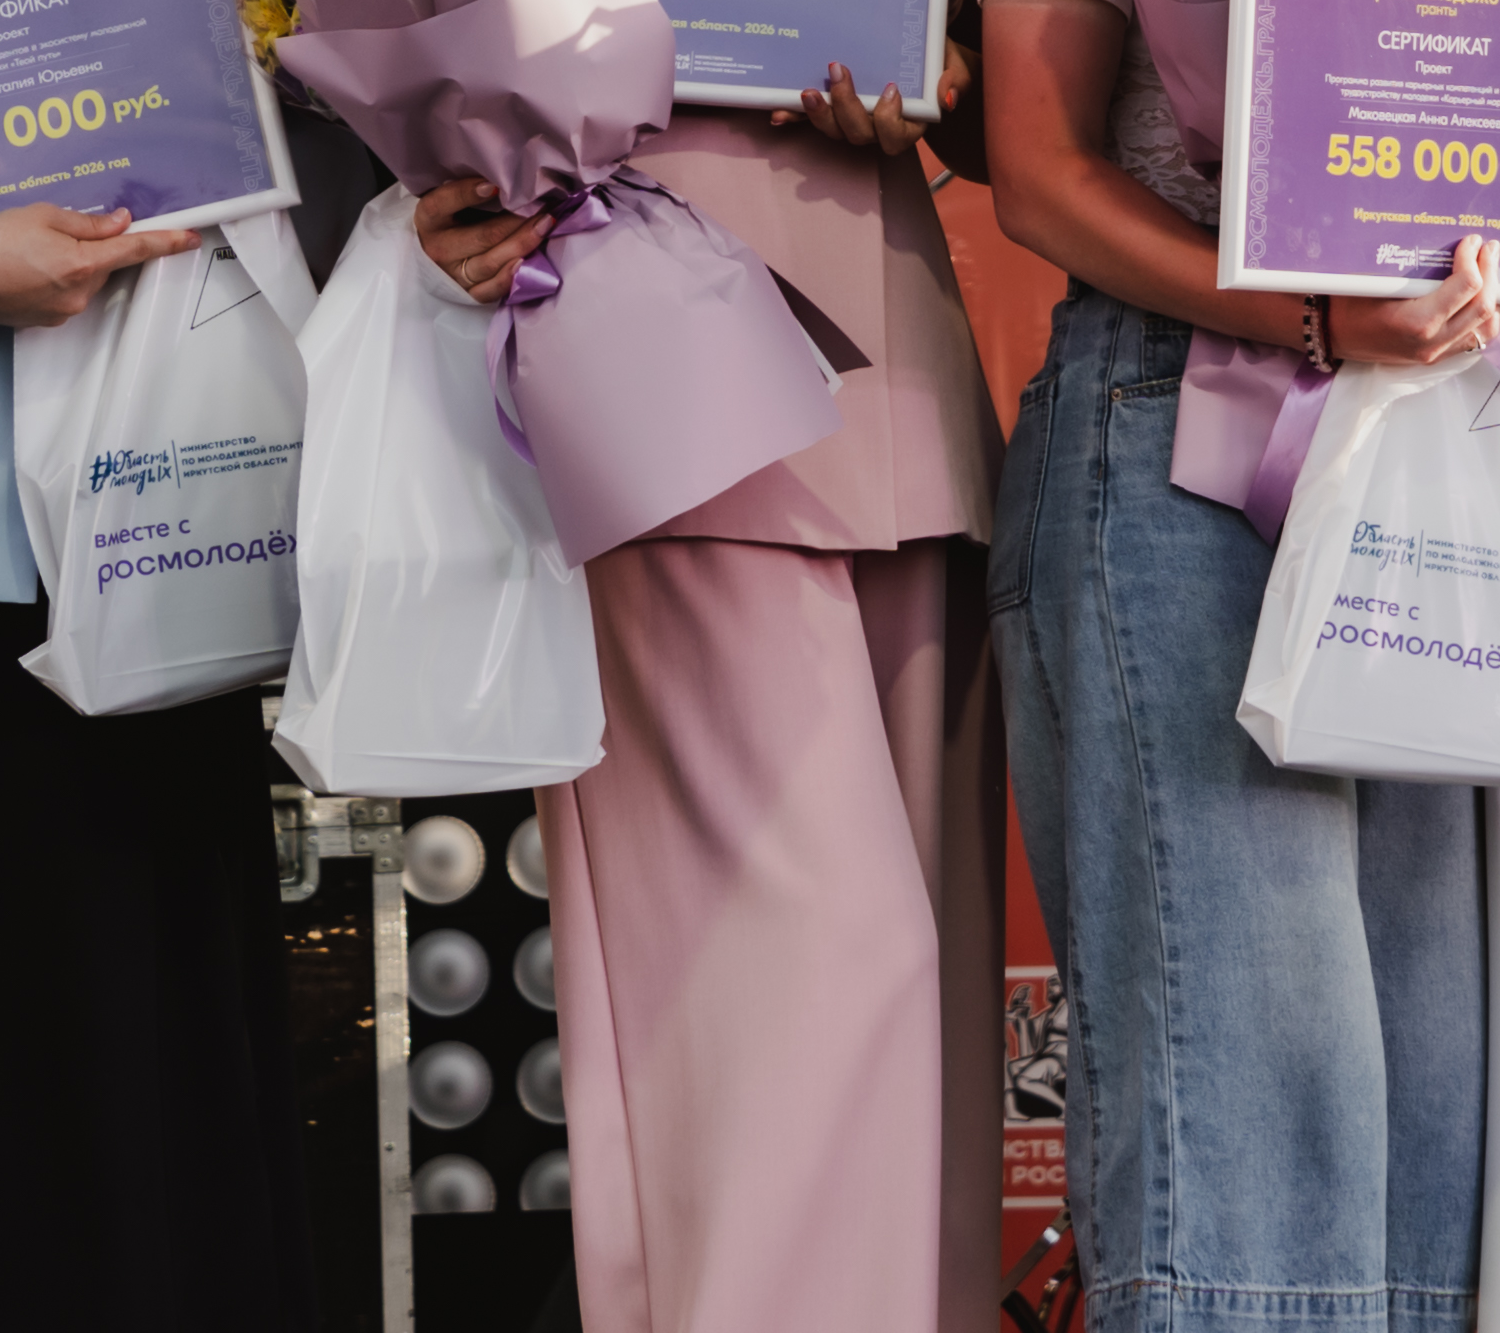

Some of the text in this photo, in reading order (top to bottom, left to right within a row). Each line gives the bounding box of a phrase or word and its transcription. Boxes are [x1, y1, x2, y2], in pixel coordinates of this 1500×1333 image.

[743, 22, 776, 36] 2026
[1377, 29, 1493, 56] СЕРТИФИКАТ
[37, 61, 104, 84] Юрьевна
[3, 89, 107, 148] 000
[112, 84, 170, 124] руб.
[1325, 133, 1402, 180] 558
[1413, 138, 1499, 186] 000
[18, 171, 72, 191] область
[72, 160, 106, 178] 2026
[107, 157, 131, 170] год
[1458, 213, 1486, 228] 2026
[180, 435, 257, 454] МИНИСТЕРСТВО
[181, 457, 196, 466] ПО
[268, 440, 303, 453] ПОЛИТ
[183, 456, 288, 478] ИРКУТСКОЙ ОБЛАСТИ
[94, 519, 191, 549] вместе с
[1424, 562, 1479, 578] ИРКУТСКОЙ
[1333, 593, 1420, 621] месте с
